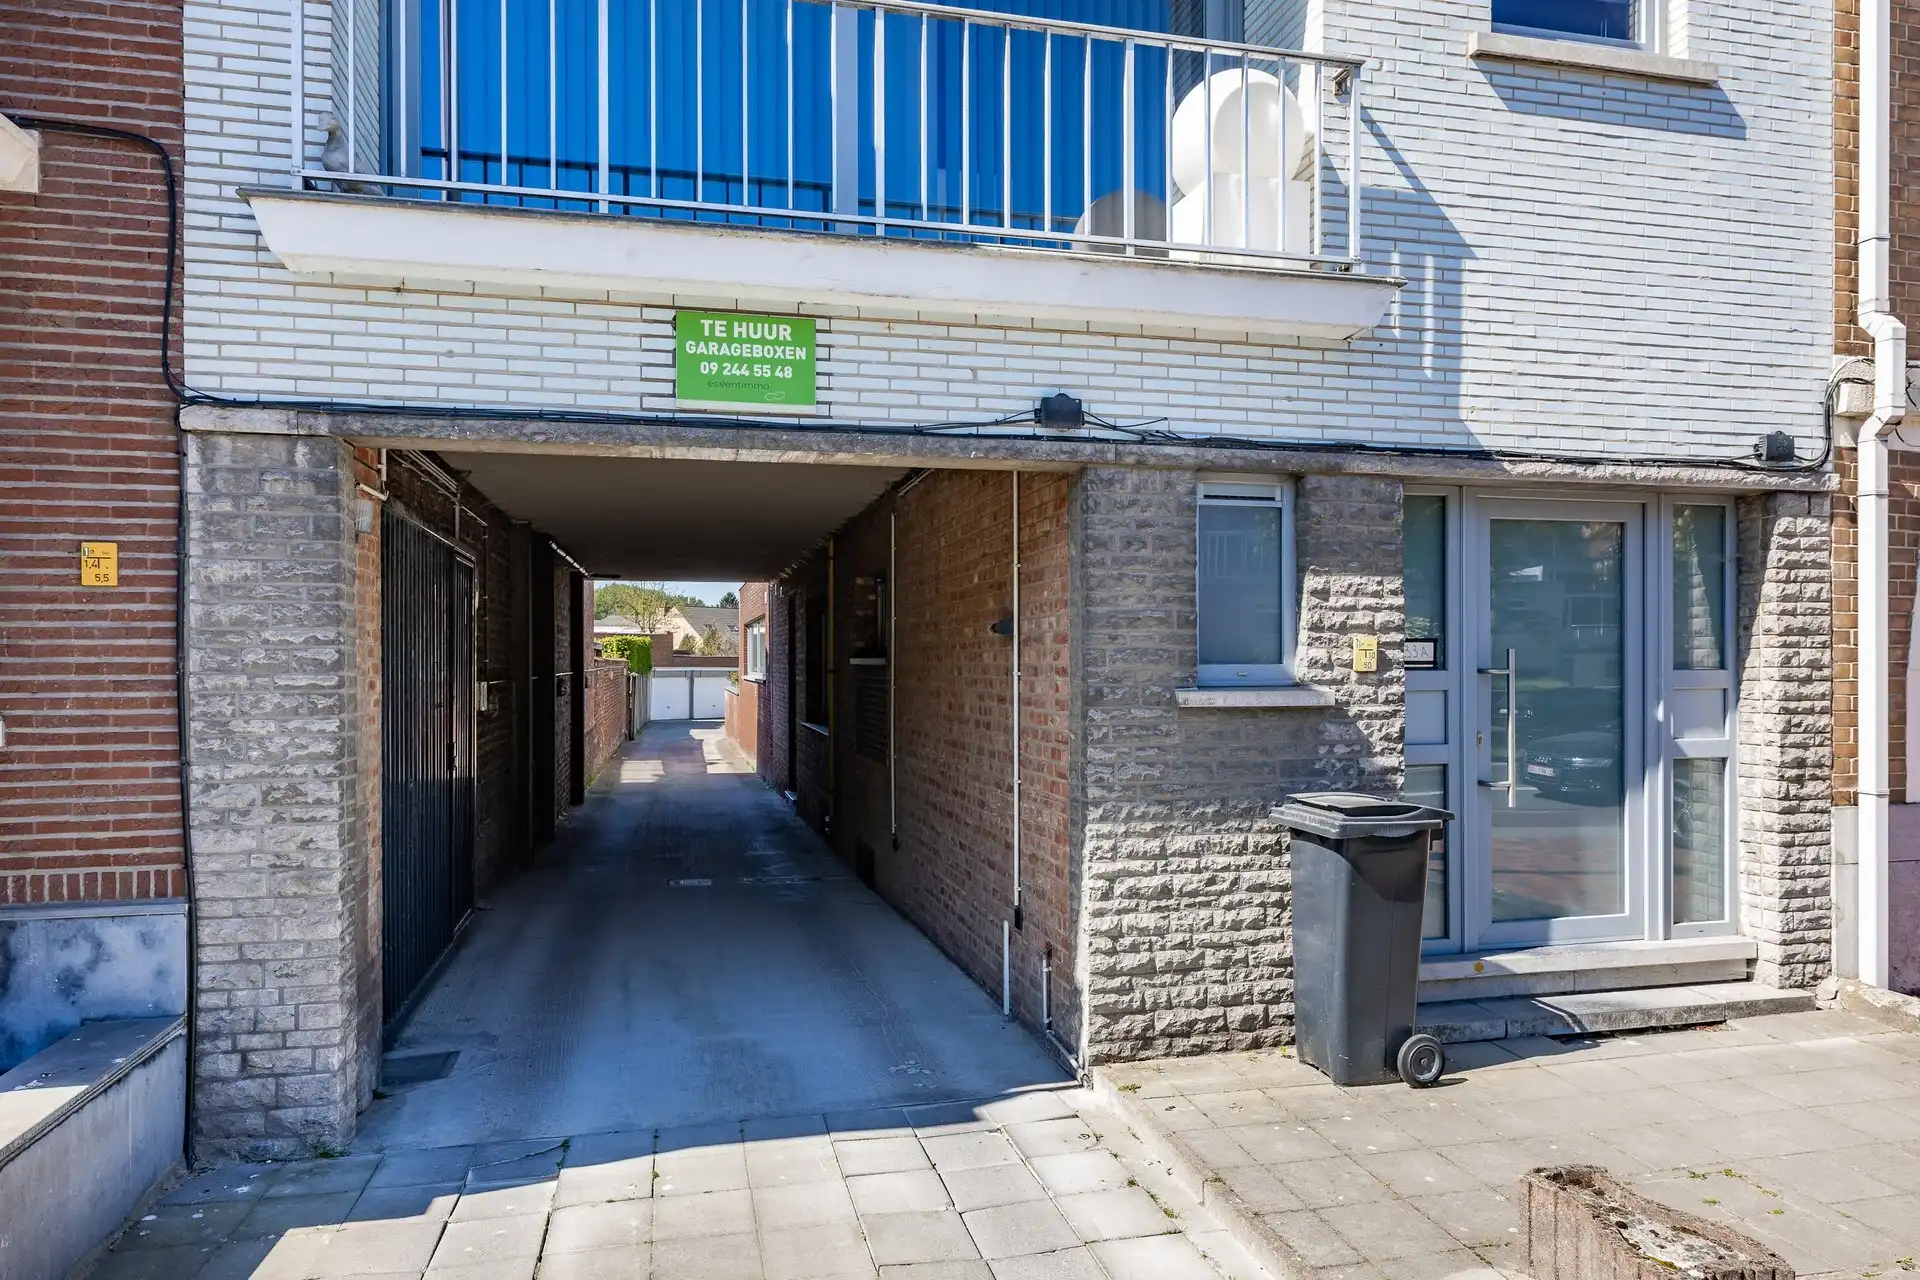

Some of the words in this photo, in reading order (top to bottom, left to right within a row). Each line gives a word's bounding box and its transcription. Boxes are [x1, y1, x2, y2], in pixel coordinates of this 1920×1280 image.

[700, 319, 727, 338] TE
[733, 321, 793, 341] HUUR
[685, 340, 807, 360] GARAGEBOXEN
[700, 361, 719, 375] 09
[722, 362, 750, 377] 244
[753, 364, 771, 378] 55
[774, 365, 793, 379] 48
